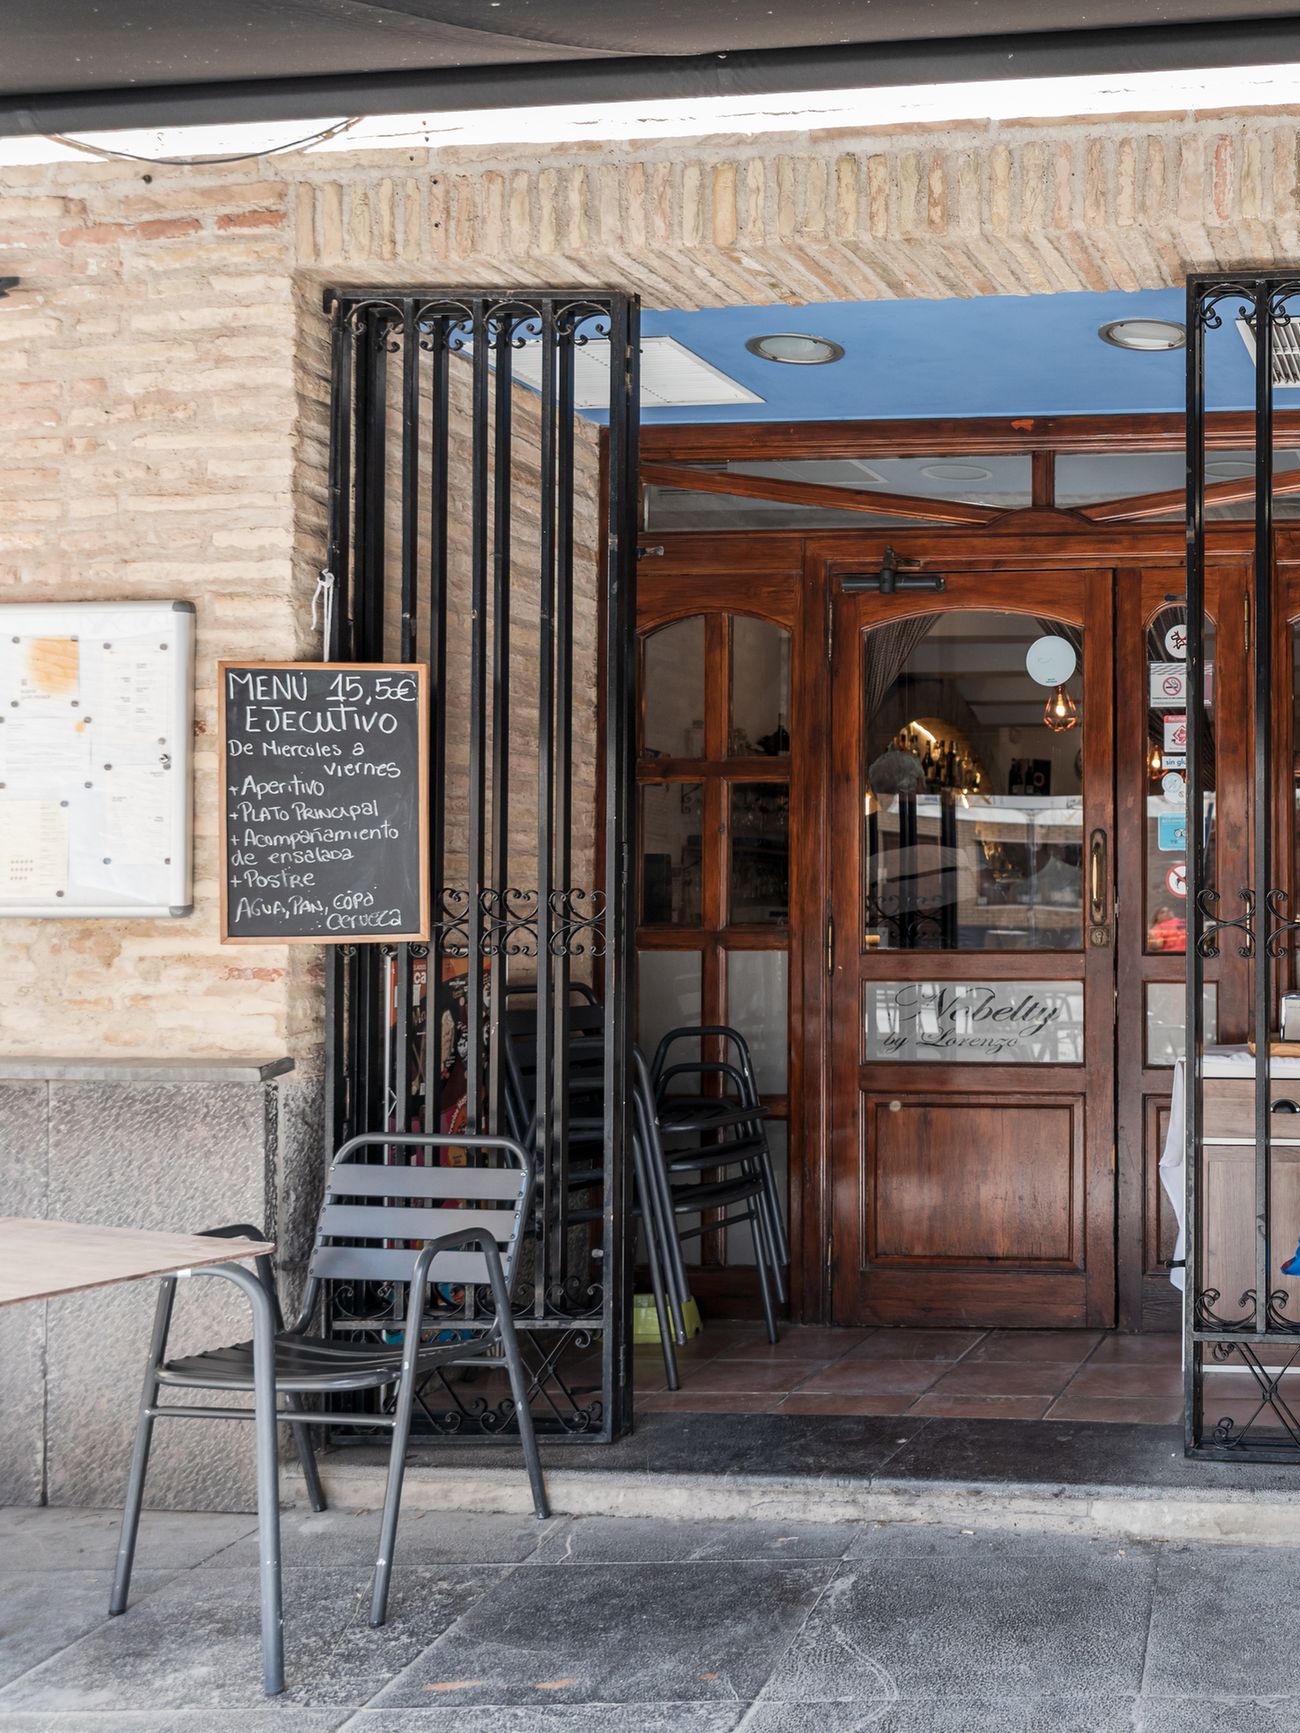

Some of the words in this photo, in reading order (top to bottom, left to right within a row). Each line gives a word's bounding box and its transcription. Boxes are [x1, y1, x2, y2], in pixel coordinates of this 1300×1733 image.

[227, 739, 254, 757] De
[352, 742, 365, 756] a
[323, 762, 401, 778] viernes
[231, 850, 258, 867] de
[895, 984, 1060, 1037] Nobelty
[883, 1031, 909, 1054] by
[915, 1026, 1020, 1055] Lorenzo
